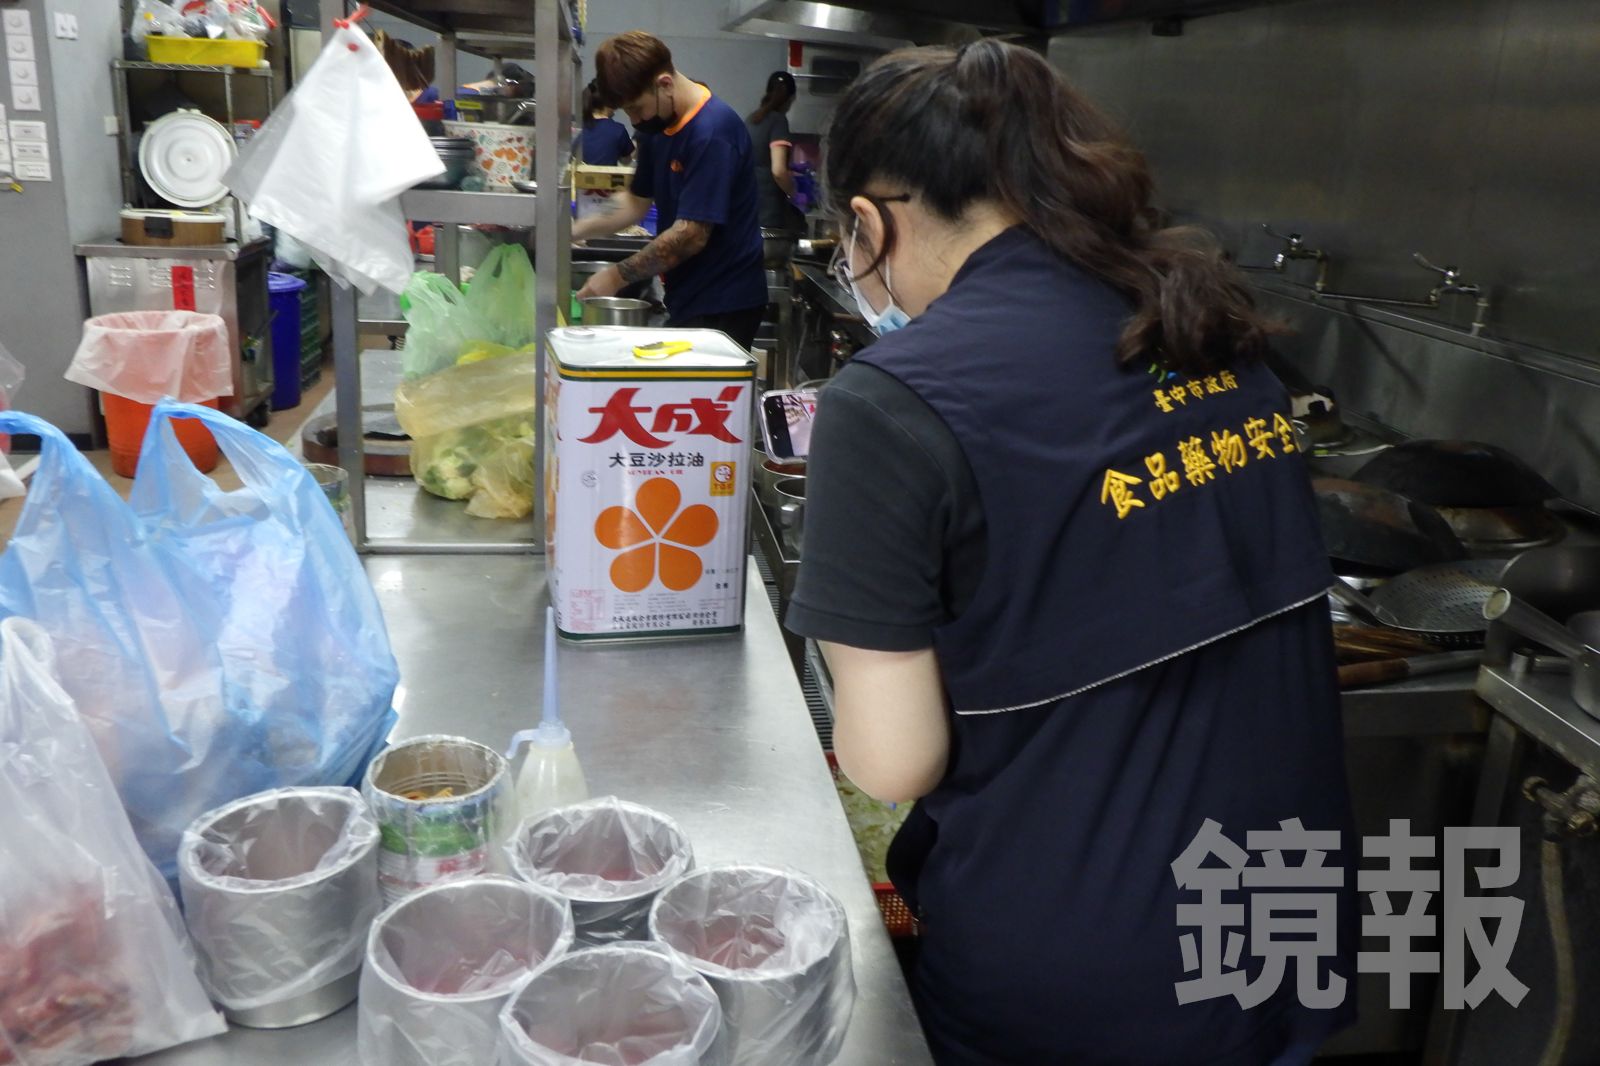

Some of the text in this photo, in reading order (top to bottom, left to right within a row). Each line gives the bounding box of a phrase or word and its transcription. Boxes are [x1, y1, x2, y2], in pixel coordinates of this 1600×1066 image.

[576, 385, 744, 449] 大成
[609, 452, 705, 468] 大豆沙拉油
[1101, 412, 1302, 519] 食品藥物安全
